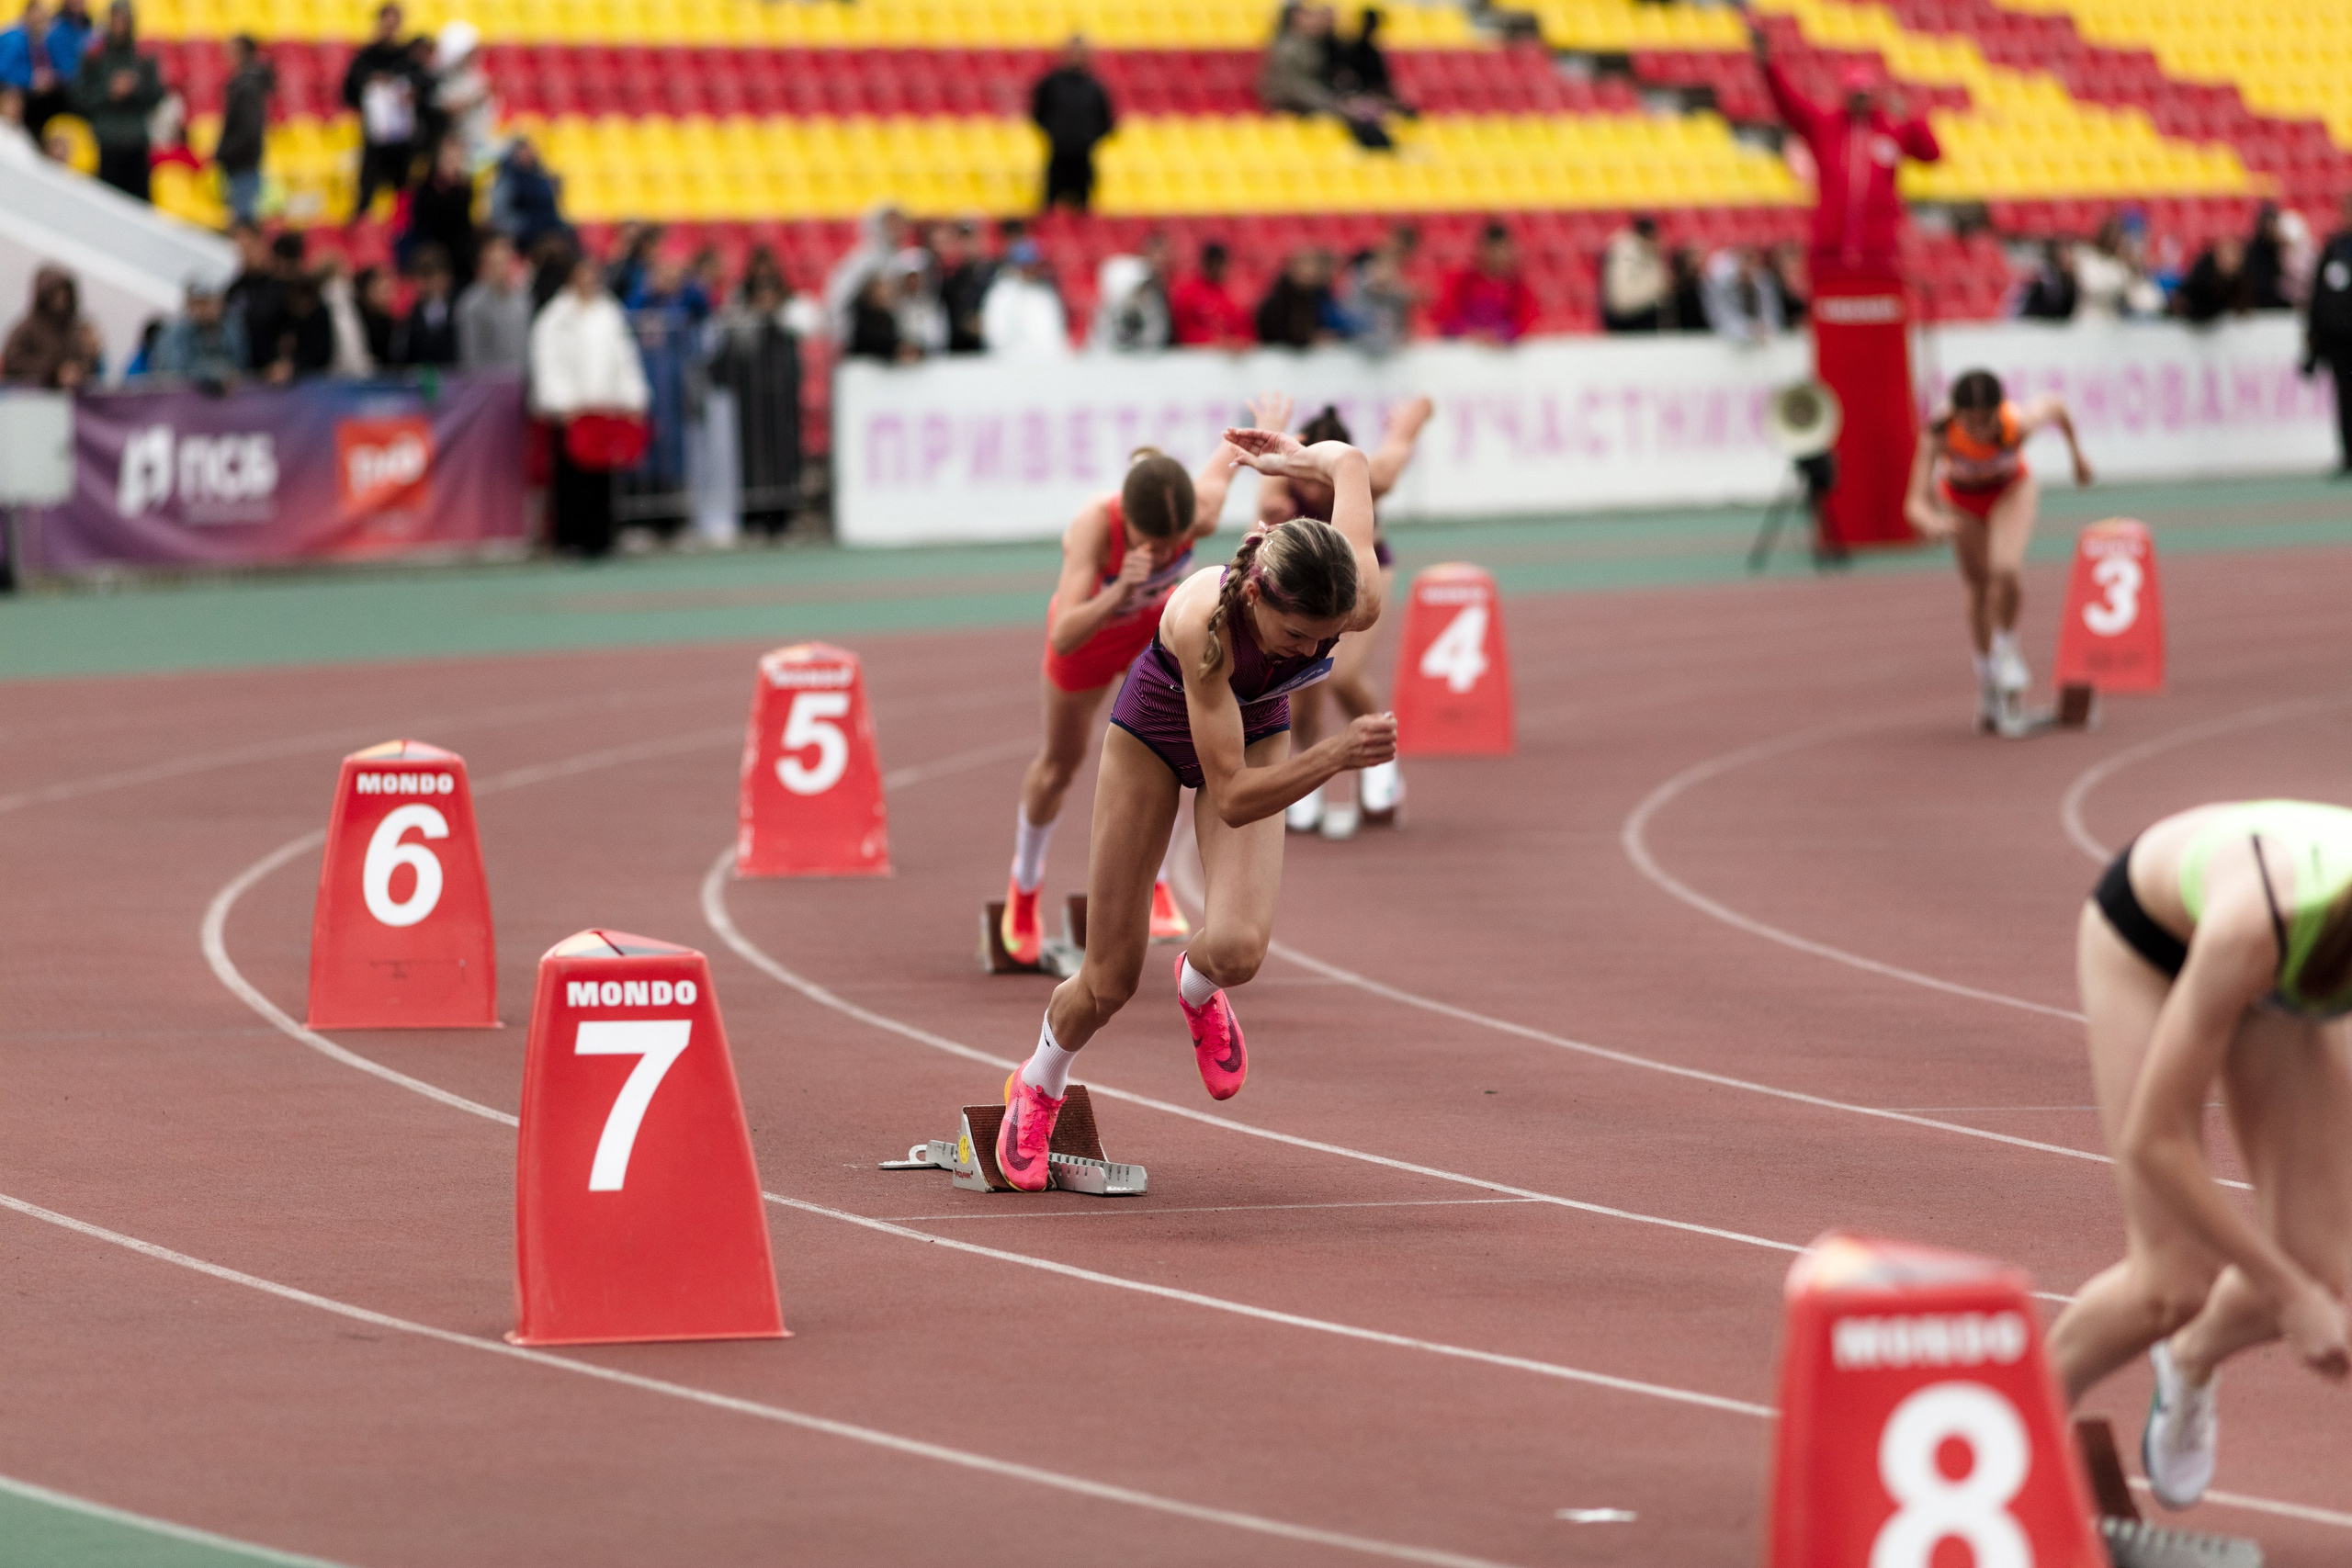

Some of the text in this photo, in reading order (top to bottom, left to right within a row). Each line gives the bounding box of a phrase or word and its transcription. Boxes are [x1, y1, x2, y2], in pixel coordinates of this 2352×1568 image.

[2082, 556, 2143, 637] 3
[1420, 606, 1489, 693] 4
[356, 773, 454, 795] MONDO
[775, 692, 850, 795] 5
[363, 803, 449, 927] 6
[566, 980, 697, 1007] MONDO
[574, 1020, 692, 1191] 7
[1868, 1381, 2035, 1568] 8
